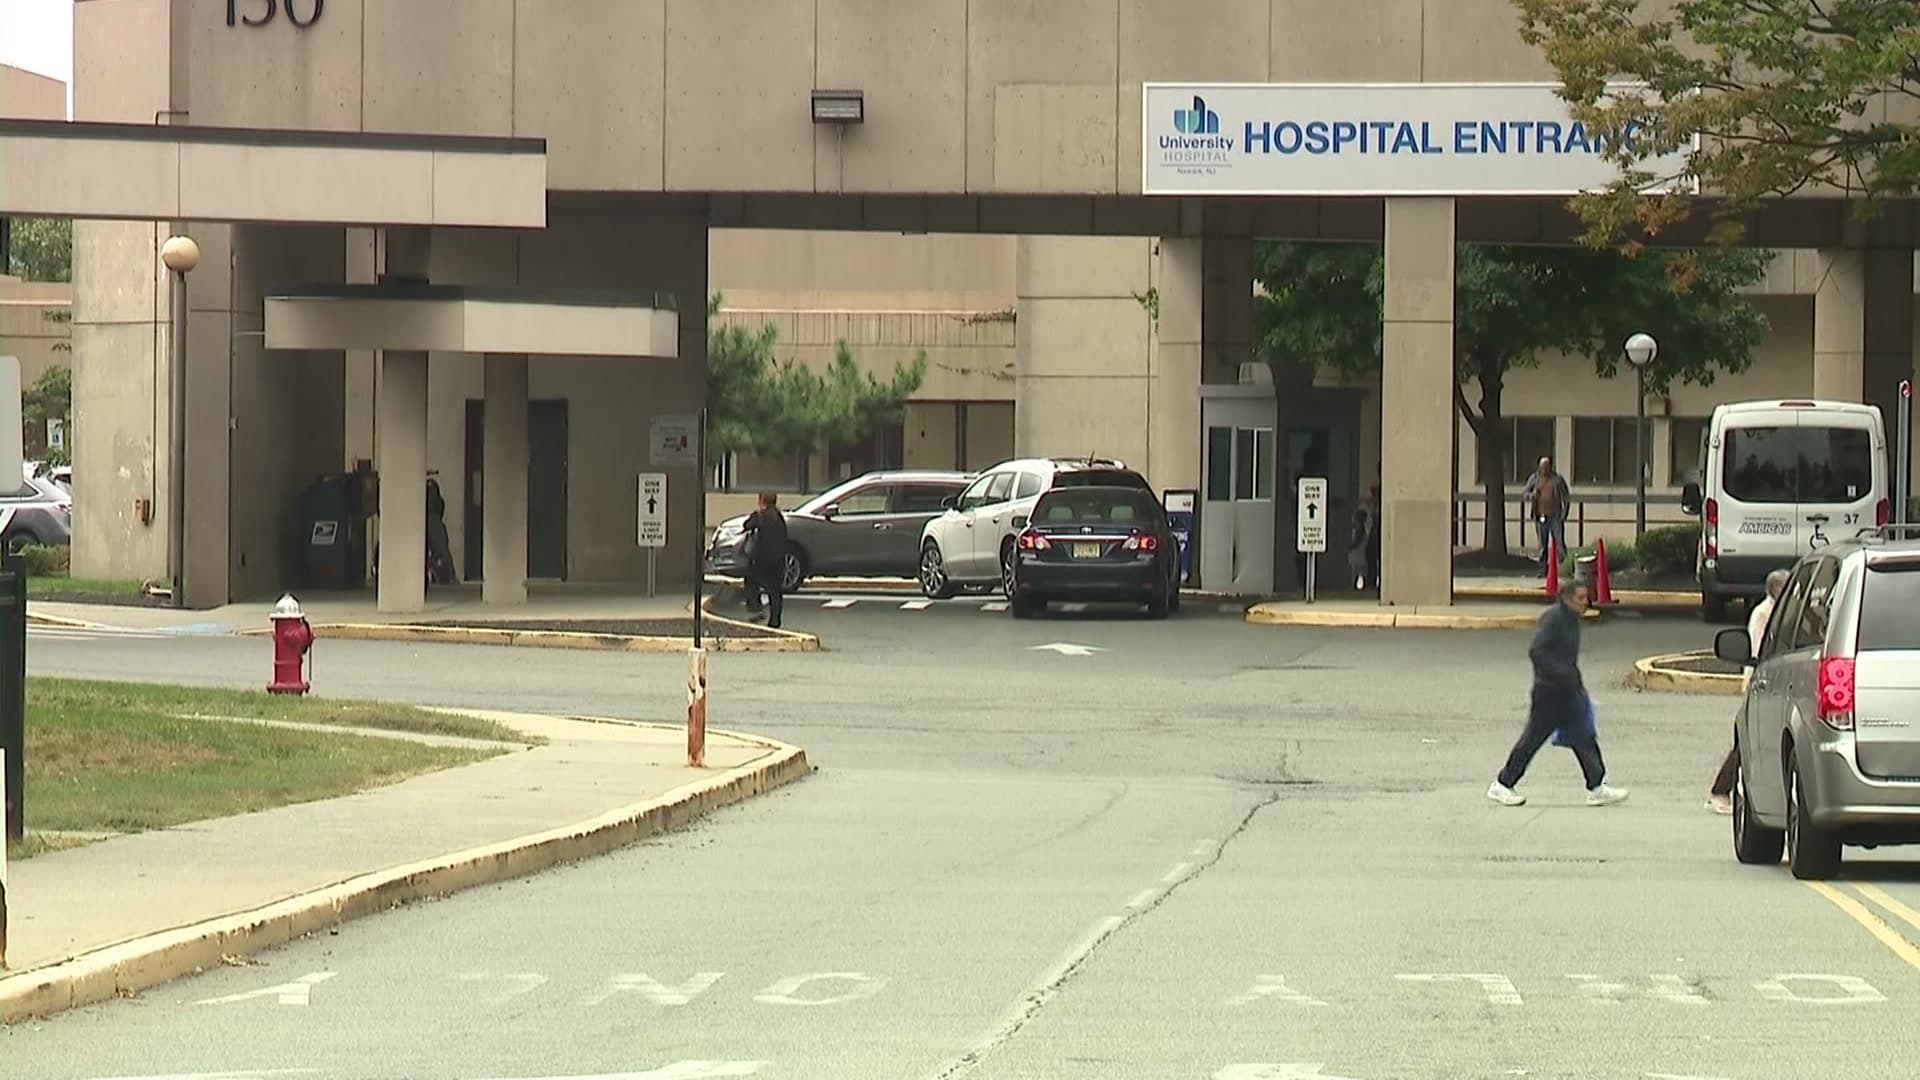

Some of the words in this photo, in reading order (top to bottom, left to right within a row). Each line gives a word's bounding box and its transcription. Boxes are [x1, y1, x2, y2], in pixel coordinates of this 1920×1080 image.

[1158, 135, 1235, 152] University
[1243, 120, 1444, 155] HOSPITAL
[1454, 120, 1680, 155] ENTRANC
[1163, 151, 1229, 162] HOSPITAL
[1843, 513, 1860, 525] 37
